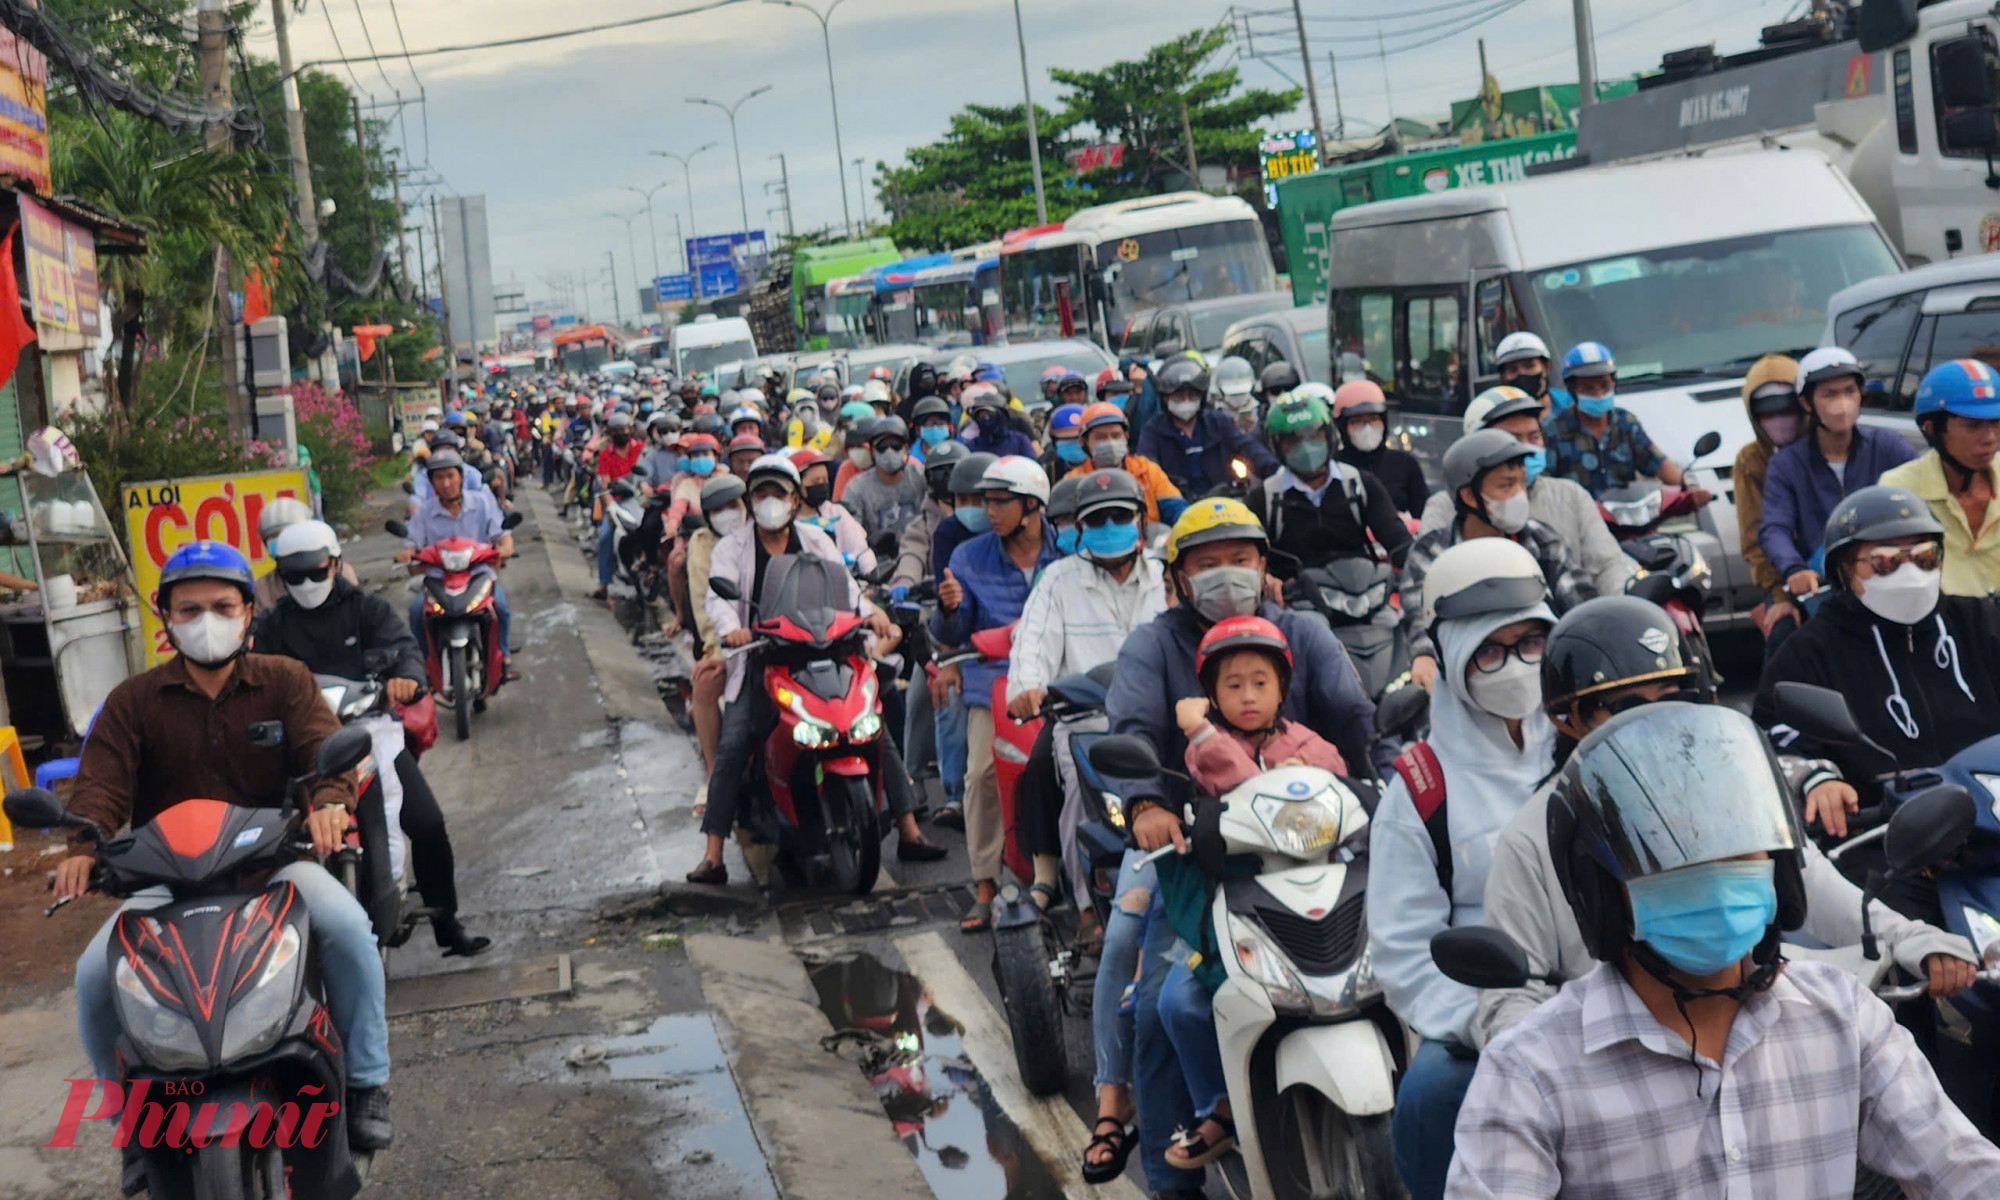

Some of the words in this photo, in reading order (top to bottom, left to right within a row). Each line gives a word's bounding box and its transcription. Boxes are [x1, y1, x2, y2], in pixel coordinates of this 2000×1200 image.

[1454, 161, 1487, 188] XE
[1287, 409, 1312, 424] Grab
[129, 490, 142, 509] A
